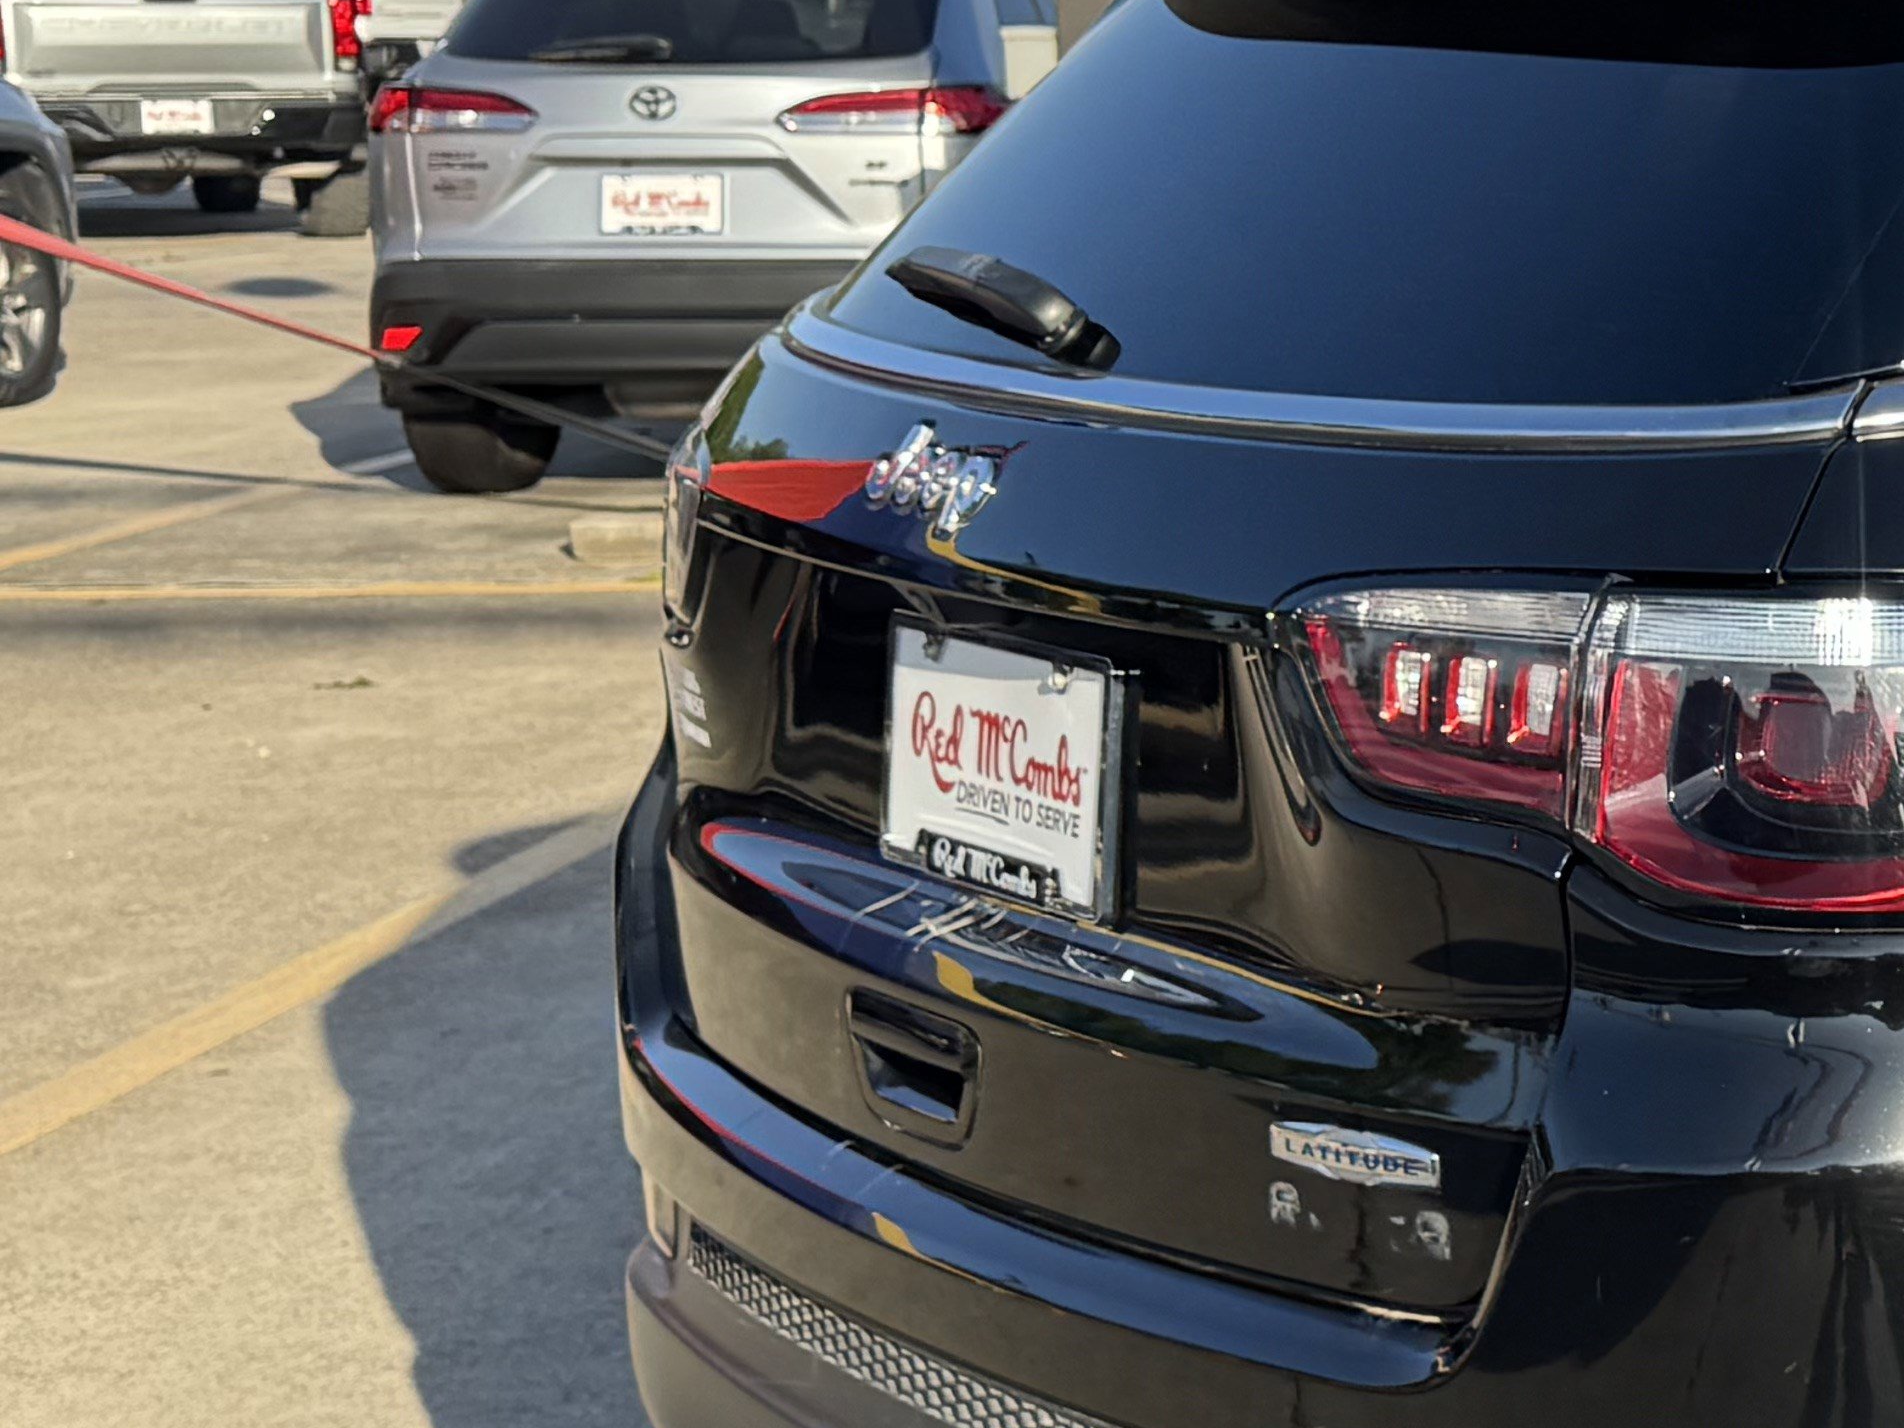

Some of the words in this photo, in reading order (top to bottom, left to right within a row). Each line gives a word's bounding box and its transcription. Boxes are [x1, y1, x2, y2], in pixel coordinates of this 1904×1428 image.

[911, 690, 964, 794] Red
[969, 705, 1081, 808] McCombs
[955, 779, 1011, 817] DRIVEN
[1014, 795, 1033, 824] TO
[1035, 803, 1081, 839] SERVE
[932, 837, 966, 879] Red
[1284, 1137, 1424, 1176] LATITUDE
